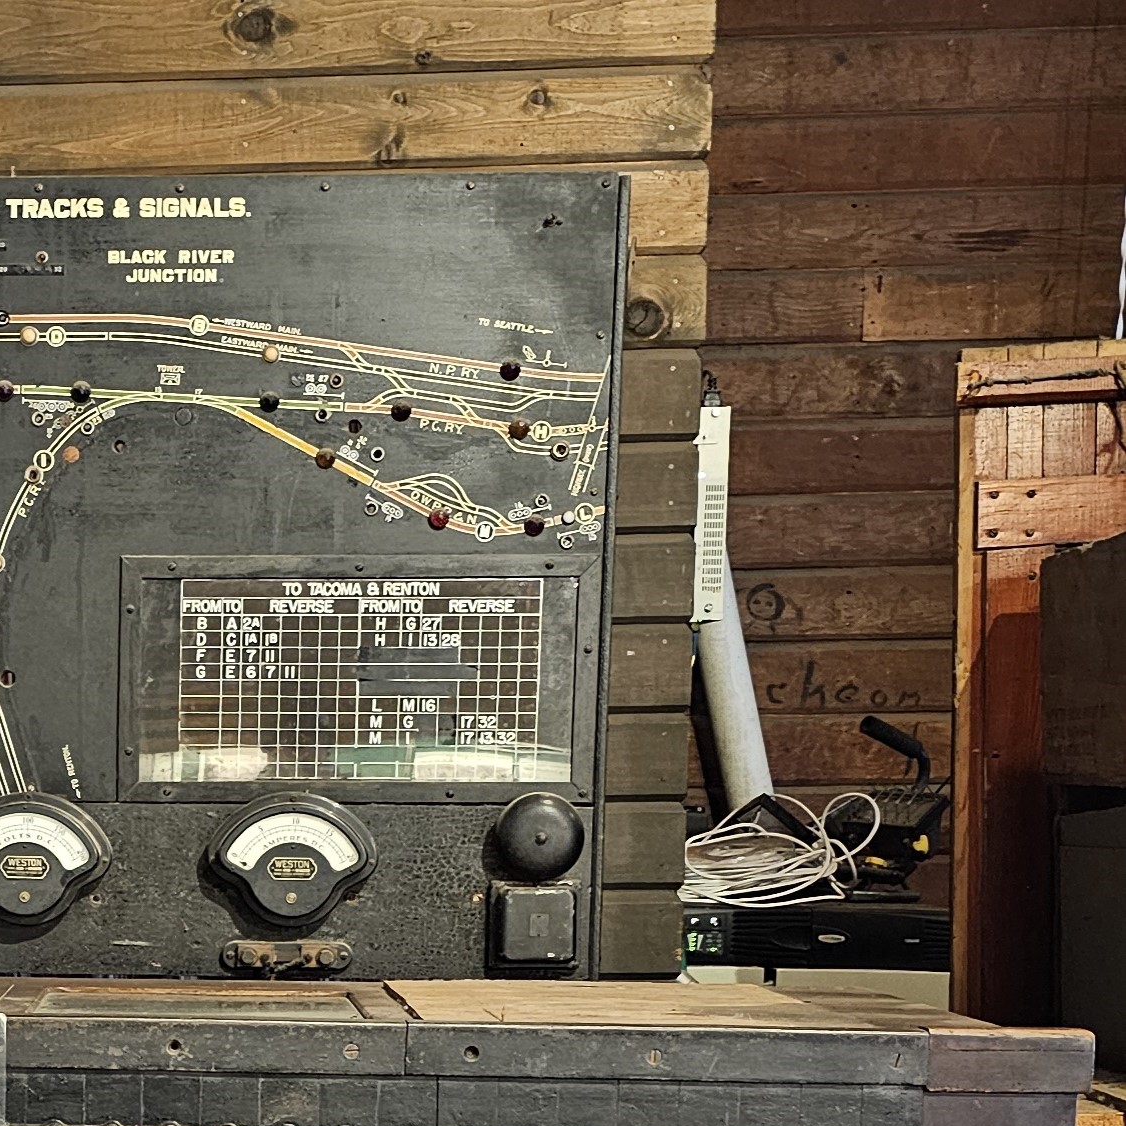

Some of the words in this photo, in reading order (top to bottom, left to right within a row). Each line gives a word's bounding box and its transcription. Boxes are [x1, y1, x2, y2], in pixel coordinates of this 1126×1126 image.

[6, 197, 104, 219] TRACKS
[112, 197, 130, 218] &
[107, 249, 167, 264] BLACK
[177, 249, 235, 264] RIVER
[193, 318, 207, 332] B
[224, 317, 272, 331] WESTWARD
[478, 317, 490, 326] TO
[50, 329, 63, 343] D
[538, 426, 547, 437] H
[579, 507, 591, 521] L
[480, 525, 490, 538] M
[282, 582, 302, 596] TO
[307, 581, 363, 596] TACOMA
[367, 582, 380, 596] &
[382, 581, 440, 596] RENTON
[182, 599, 222, 613] FROM
[223, 599, 241, 613] TO
[269, 599, 334, 613] REVERSE
[360, 599, 400, 613] FROM
[402, 599, 421, 613] TO
[448, 599, 515, 613] REVERSE
[196, 616, 207, 630] B
[226, 616, 238, 630] A
[242, 617, 260, 631] 2A
[375, 617, 387, 630] H
[405, 617, 416, 631] G
[422, 617, 441, 631] 27
[196, 633, 207, 646] D
[225, 633, 237, 646] C
[374, 633, 386, 647] H
[423, 633, 438, 647] 13
[441, 633, 461, 647] 28
[195, 649, 207, 662] F
[225, 649, 236, 662] E
[245, 649, 257, 663] 7
[195, 665, 206, 678] G
[225, 665, 236, 679] E
[245, 665, 257, 679] 6
[265, 665, 276, 679] 7
[371, 698, 382, 712] L
[402, 698, 415, 712] M
[421, 699, 436, 712] 16
[369, 715, 383, 728] M
[402, 715, 414, 729] G
[460, 715, 474, 729] 17
[477, 715, 497, 729] 32
[368, 731, 382, 744] M
[460, 731, 474, 745] 17
[496, 731, 516, 745] 32
[263, 834, 308, 850] AMPERES
[8, 857, 43, 867] WESTON
[274, 859, 310, 869] WESTON
